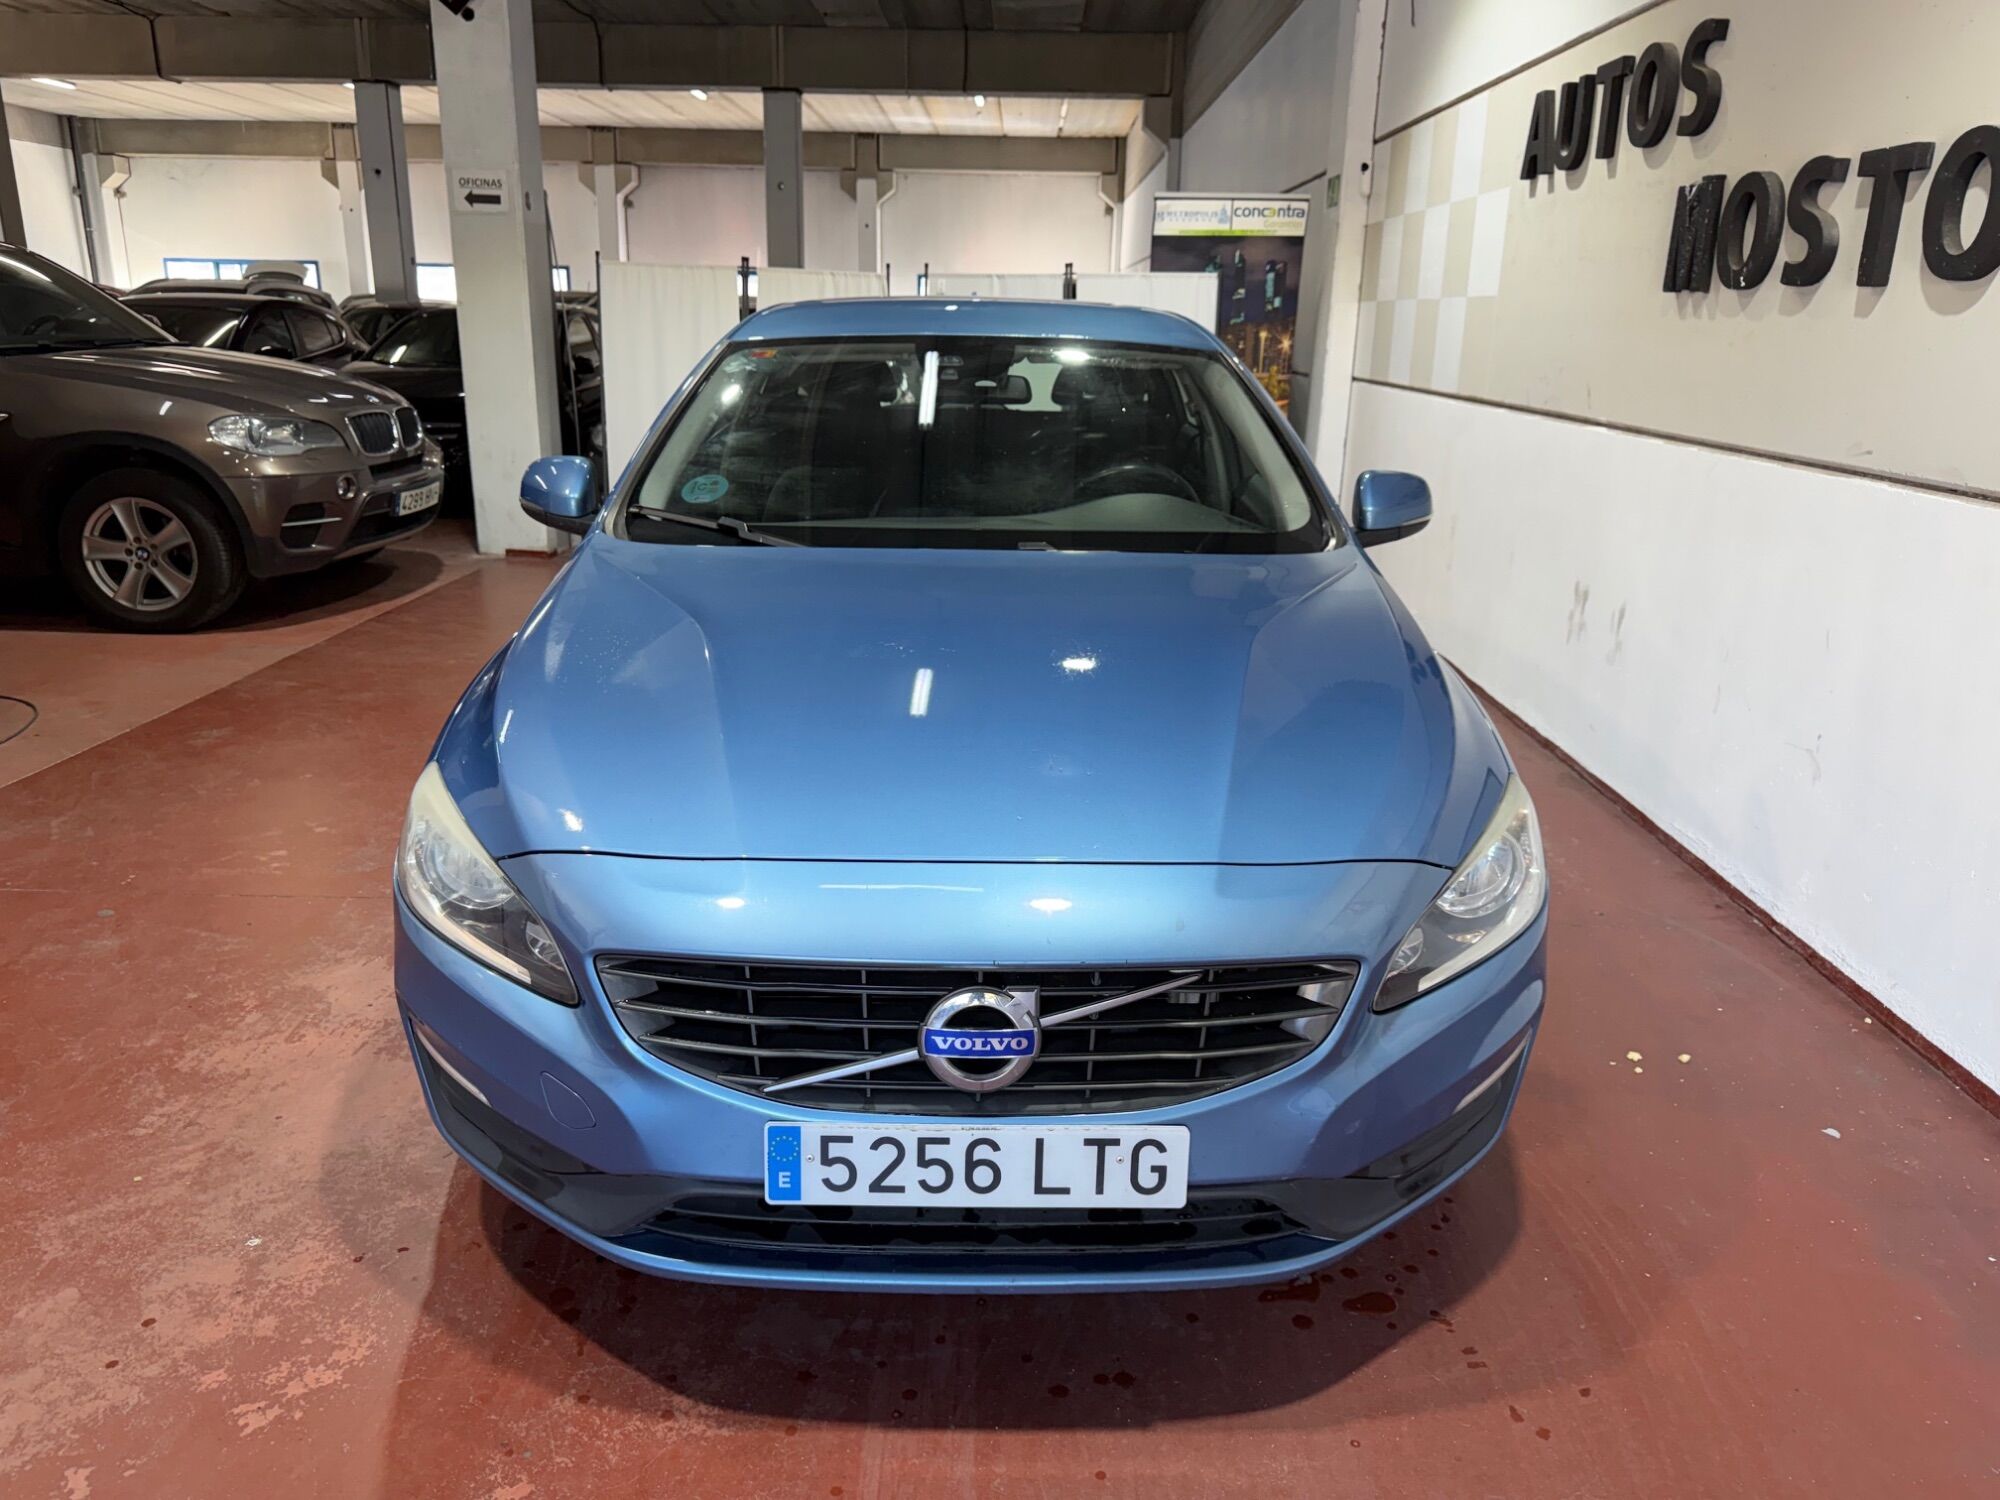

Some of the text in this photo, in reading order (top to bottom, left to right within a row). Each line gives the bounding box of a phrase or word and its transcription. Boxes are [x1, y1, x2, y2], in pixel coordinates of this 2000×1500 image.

[1520, 18, 1730, 180] AUTOS
[458, 177, 503, 189] OFICINAS
[1233, 204, 1306, 218] concentra
[931, 1035, 1029, 1051] VOLVO
[819, 1135, 1168, 1195] 5256 LTG
[779, 1171, 791, 1188] E
